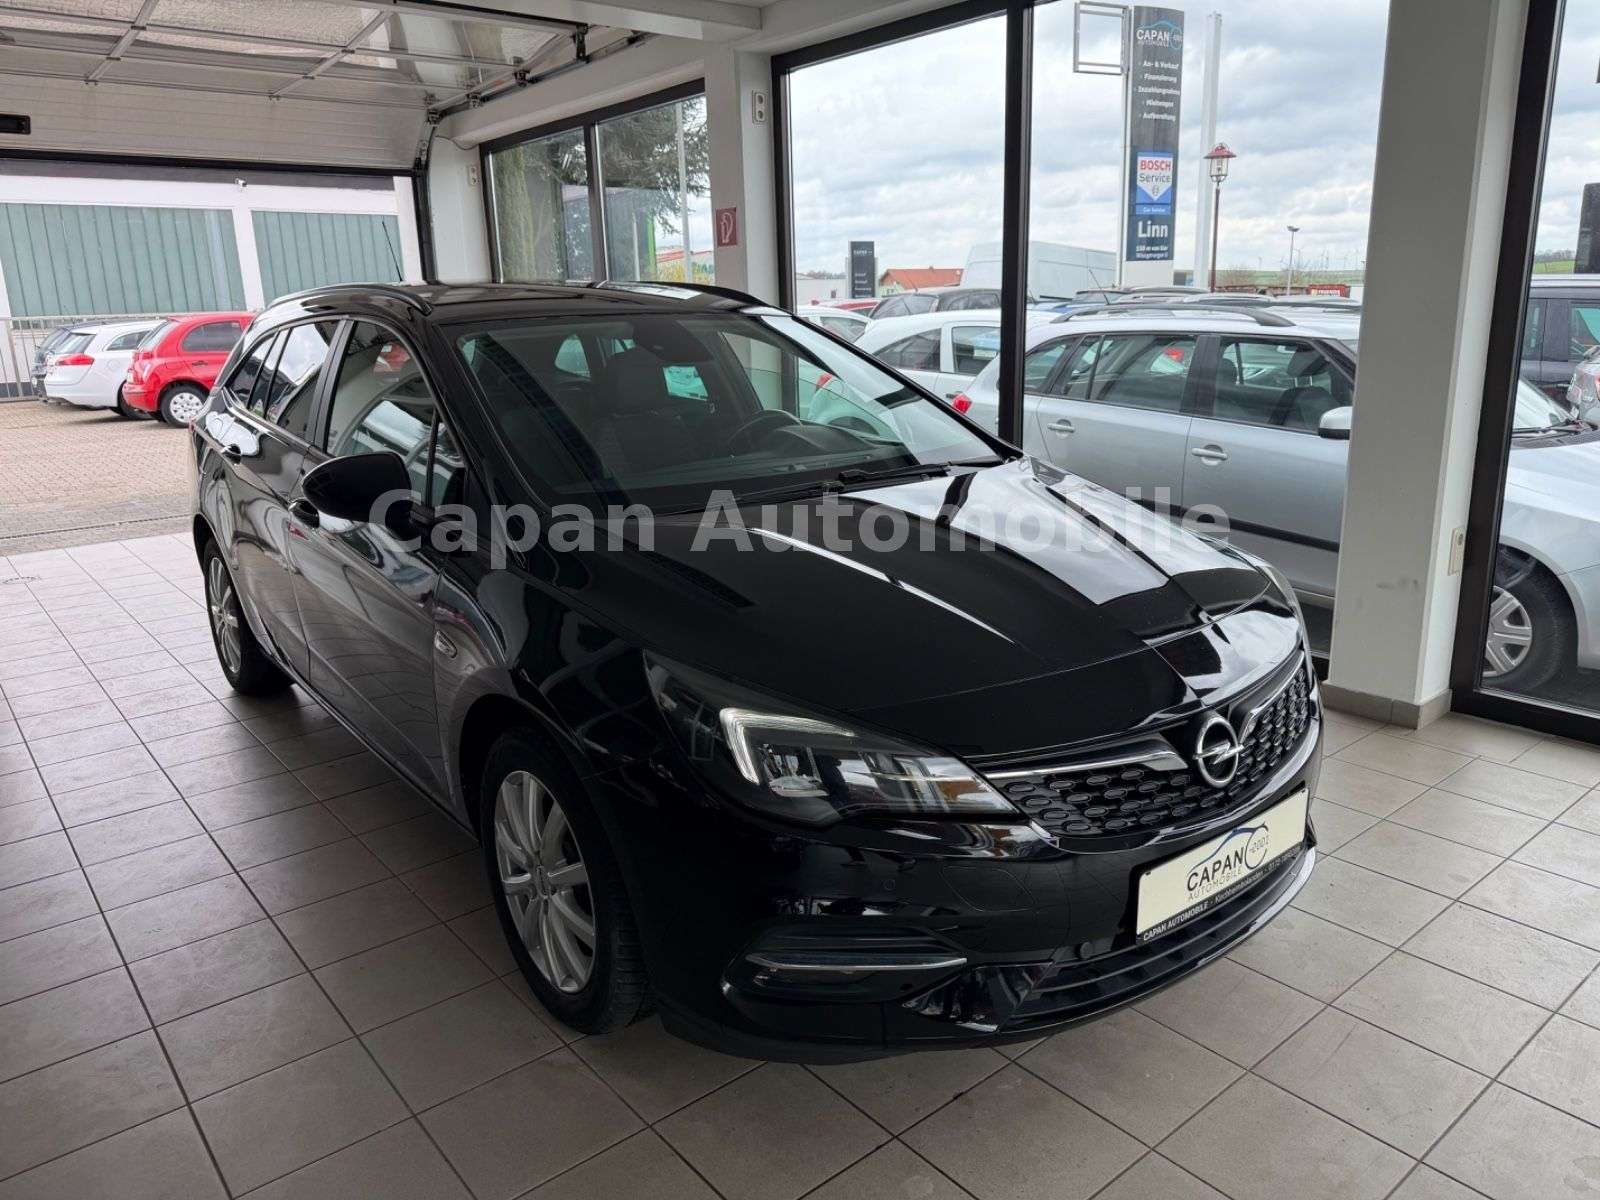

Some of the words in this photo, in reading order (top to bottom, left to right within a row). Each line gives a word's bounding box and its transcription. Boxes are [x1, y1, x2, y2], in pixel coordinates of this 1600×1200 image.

[1136, 29, 1169, 41] CAPAN
[1140, 159, 1171, 171] BOSCH
[1139, 173, 1171, 183] Service
[1138, 220, 1168, 238] Linn
[1187, 846, 1245, 892] CAPAN
[1189, 867, 1243, 901] AUTOMOBILE
[1143, 922, 1167, 941] CAPAN
[1167, 900, 1209, 930] AUTOMOBILE
